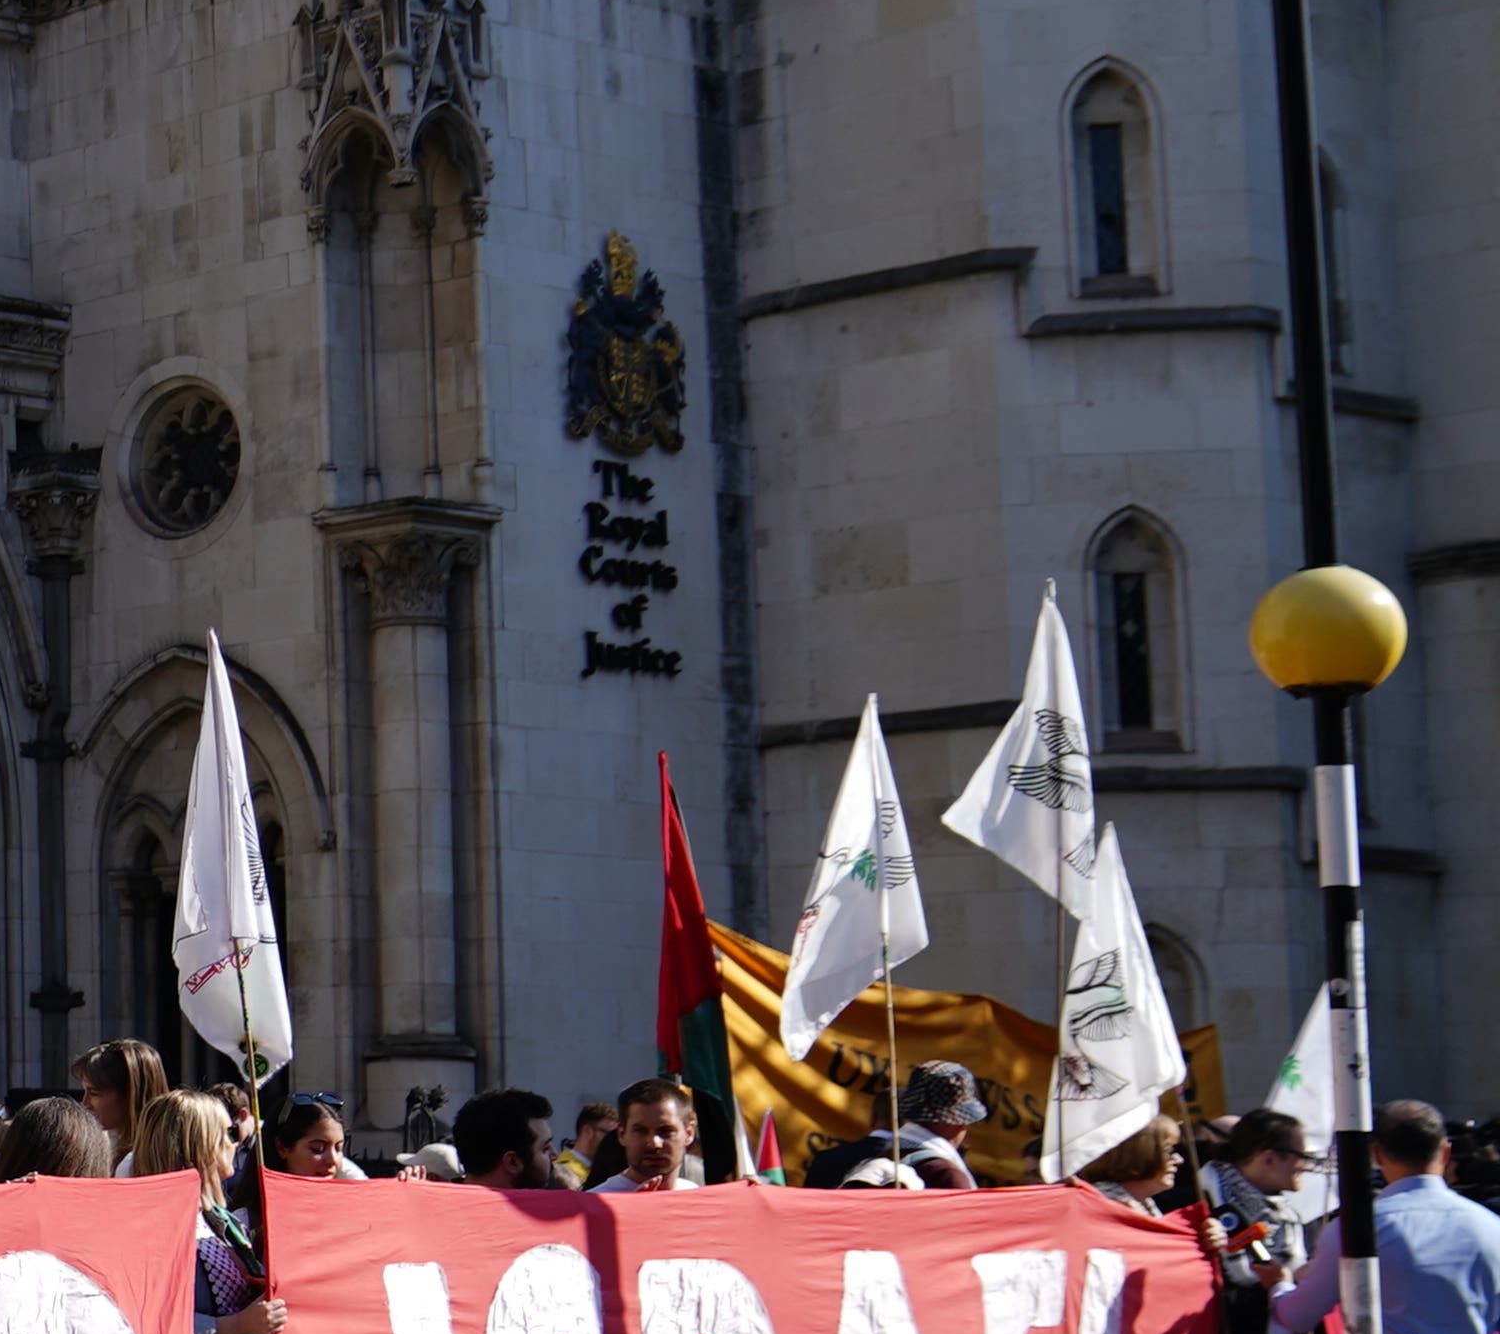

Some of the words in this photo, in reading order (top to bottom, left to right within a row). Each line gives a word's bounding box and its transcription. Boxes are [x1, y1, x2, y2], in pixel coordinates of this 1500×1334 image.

[592, 460, 655, 504] The
[583, 502, 670, 553] Royal
[579, 545, 679, 591] Courts
[612, 593, 649, 631] of
[580, 631, 682, 680] Justice
